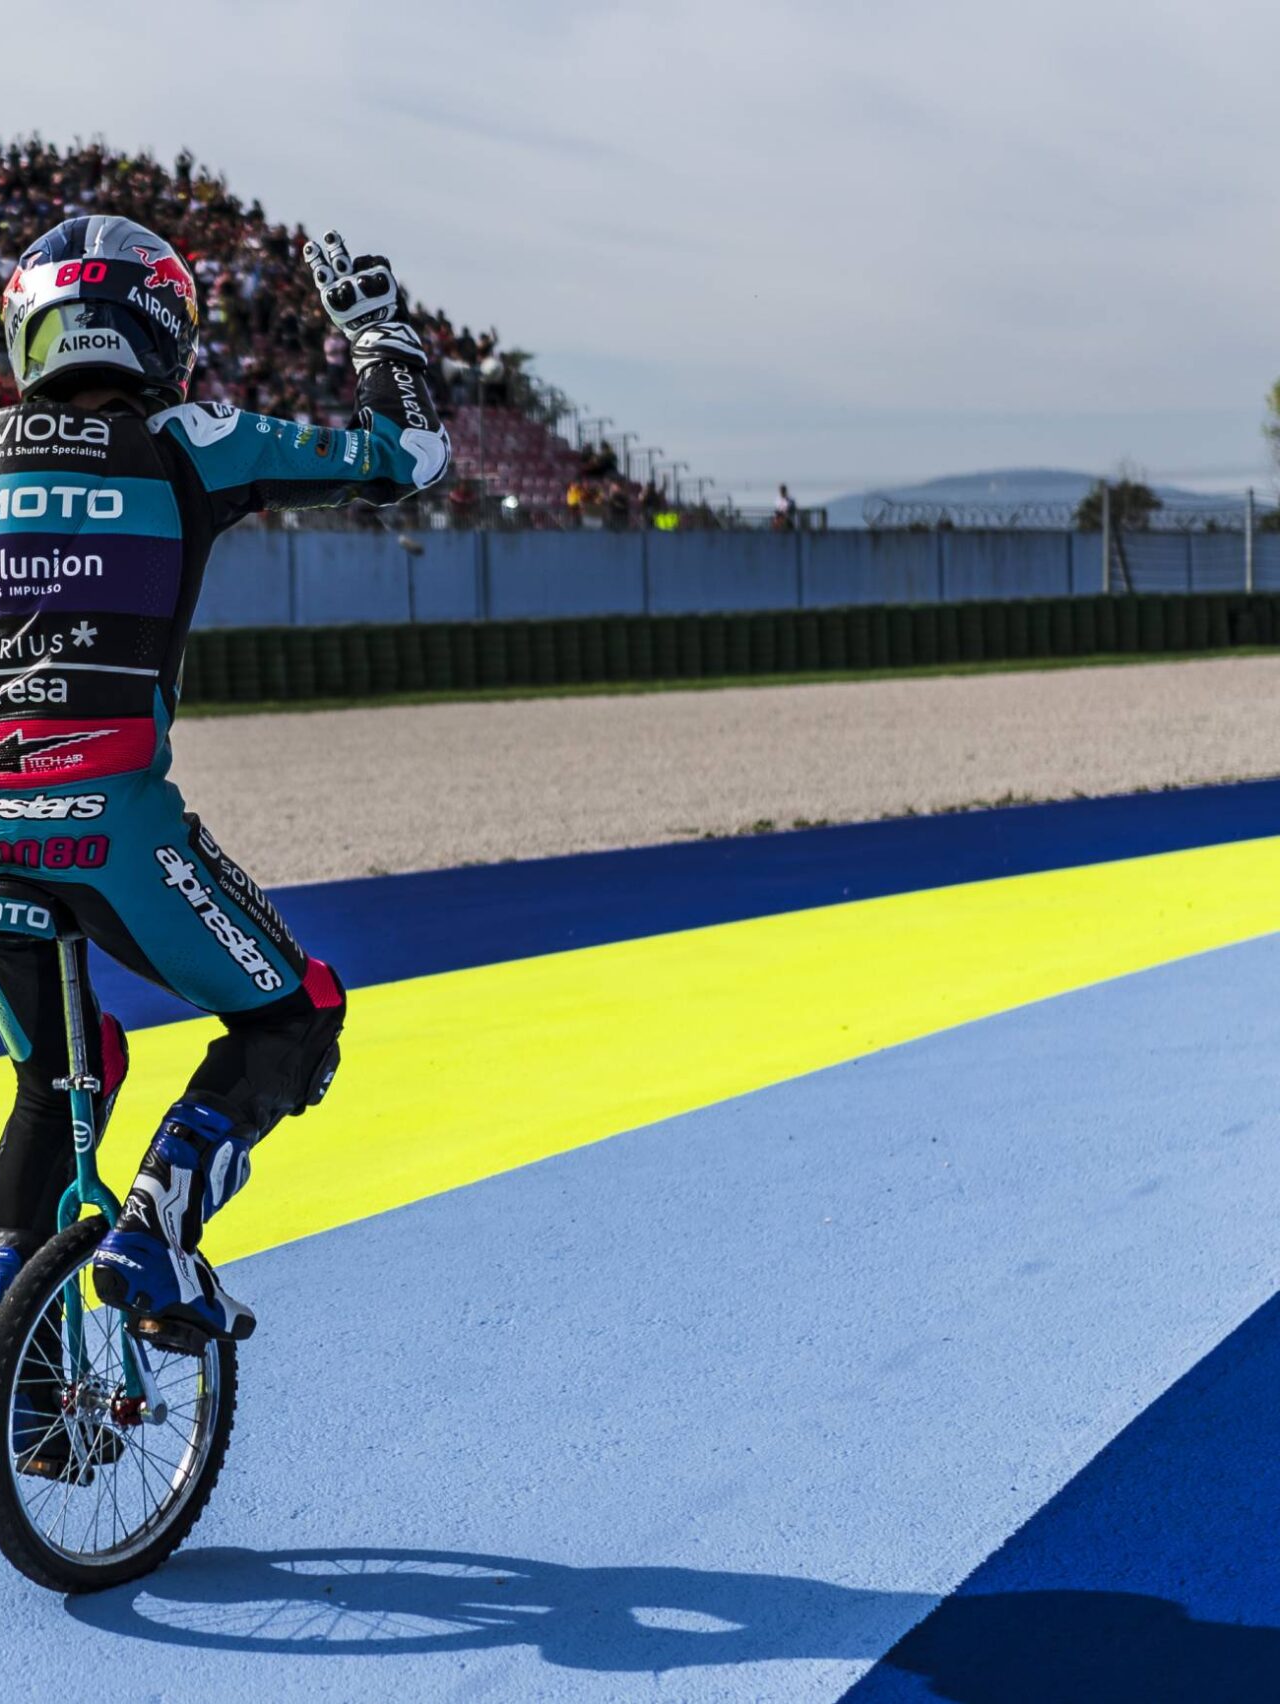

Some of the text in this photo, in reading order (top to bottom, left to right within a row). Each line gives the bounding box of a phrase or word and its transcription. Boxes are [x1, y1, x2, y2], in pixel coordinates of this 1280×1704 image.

[55, 261, 108, 287] 80
[7, 292, 37, 350] AIROH
[127, 286, 181, 338] AIROH
[58, 334, 120, 353] AIROH
[7, 447, 13, 456] &
[15, 446, 49, 456] Shutter
[52, 445, 107, 459] Specialists
[9, 583, 62, 597] IMPULSO
[156, 847, 282, 991] alpinestars
[247, 903, 281, 942] IMPULSO
